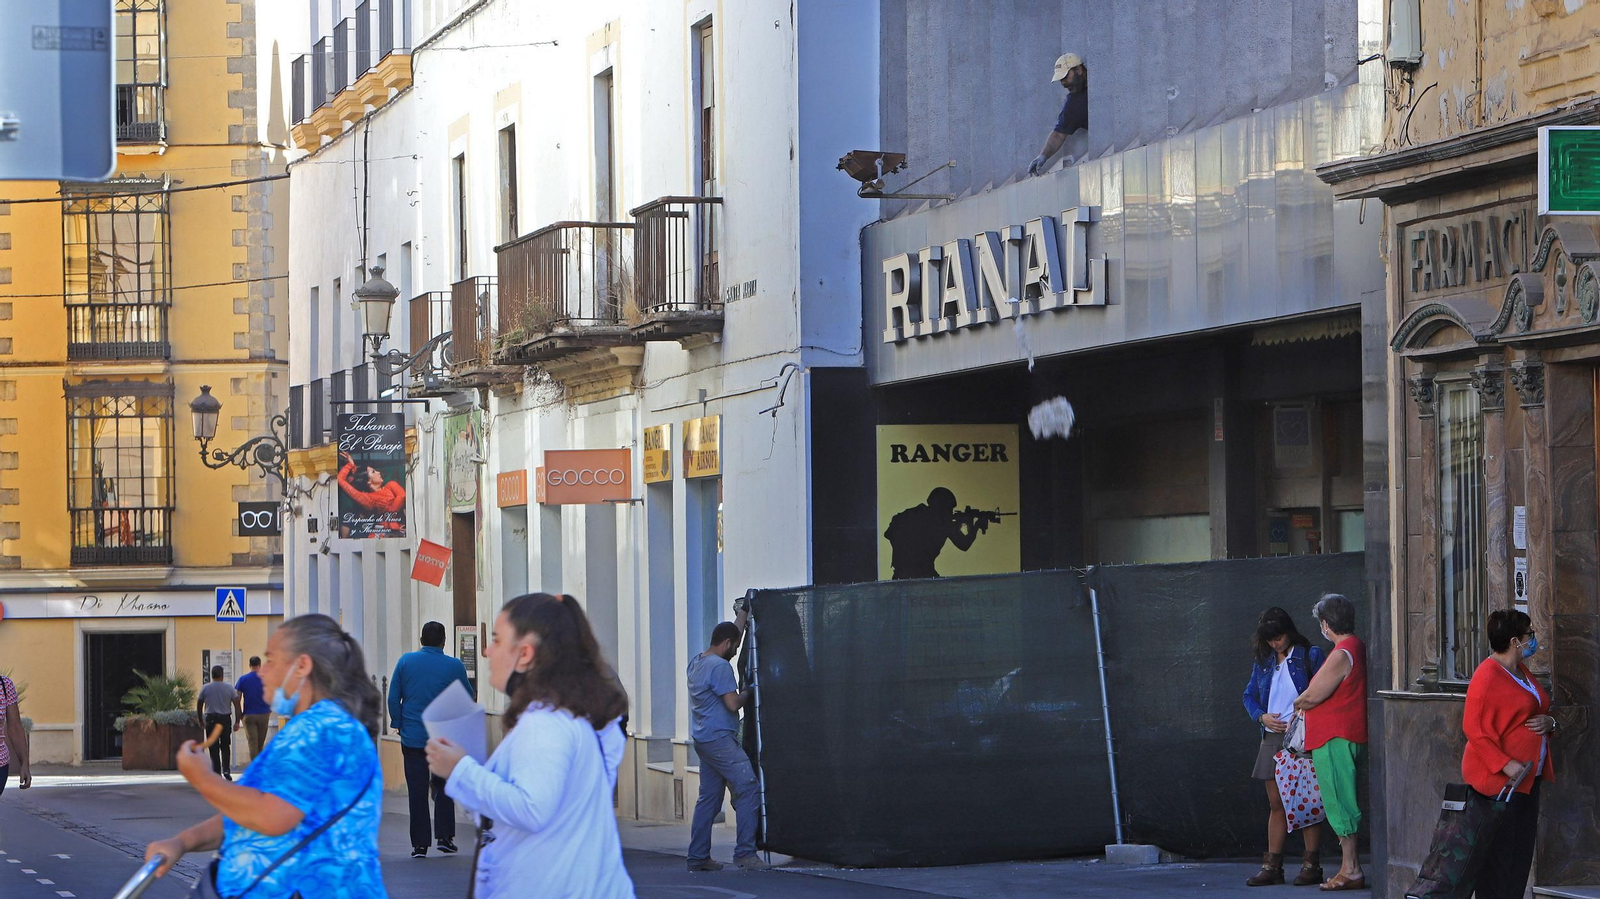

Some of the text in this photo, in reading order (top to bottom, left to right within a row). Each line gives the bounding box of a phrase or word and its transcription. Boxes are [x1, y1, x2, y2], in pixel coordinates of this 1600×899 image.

[882, 206, 1108, 343] RIANAL
[344, 413, 397, 431] Tabanco
[339, 433, 403, 455] El Pasaje
[890, 443, 1009, 463] RANGER
[696, 449, 718, 471] AIRSOFT
[547, 468, 625, 486] GOCCO
[500, 476, 520, 502] GOCCO
[342, 512, 375, 526] Despacho
[375, 514, 383, 522] de
[359, 522, 392, 534] Flamenco
[76, 594, 103, 610] Di
